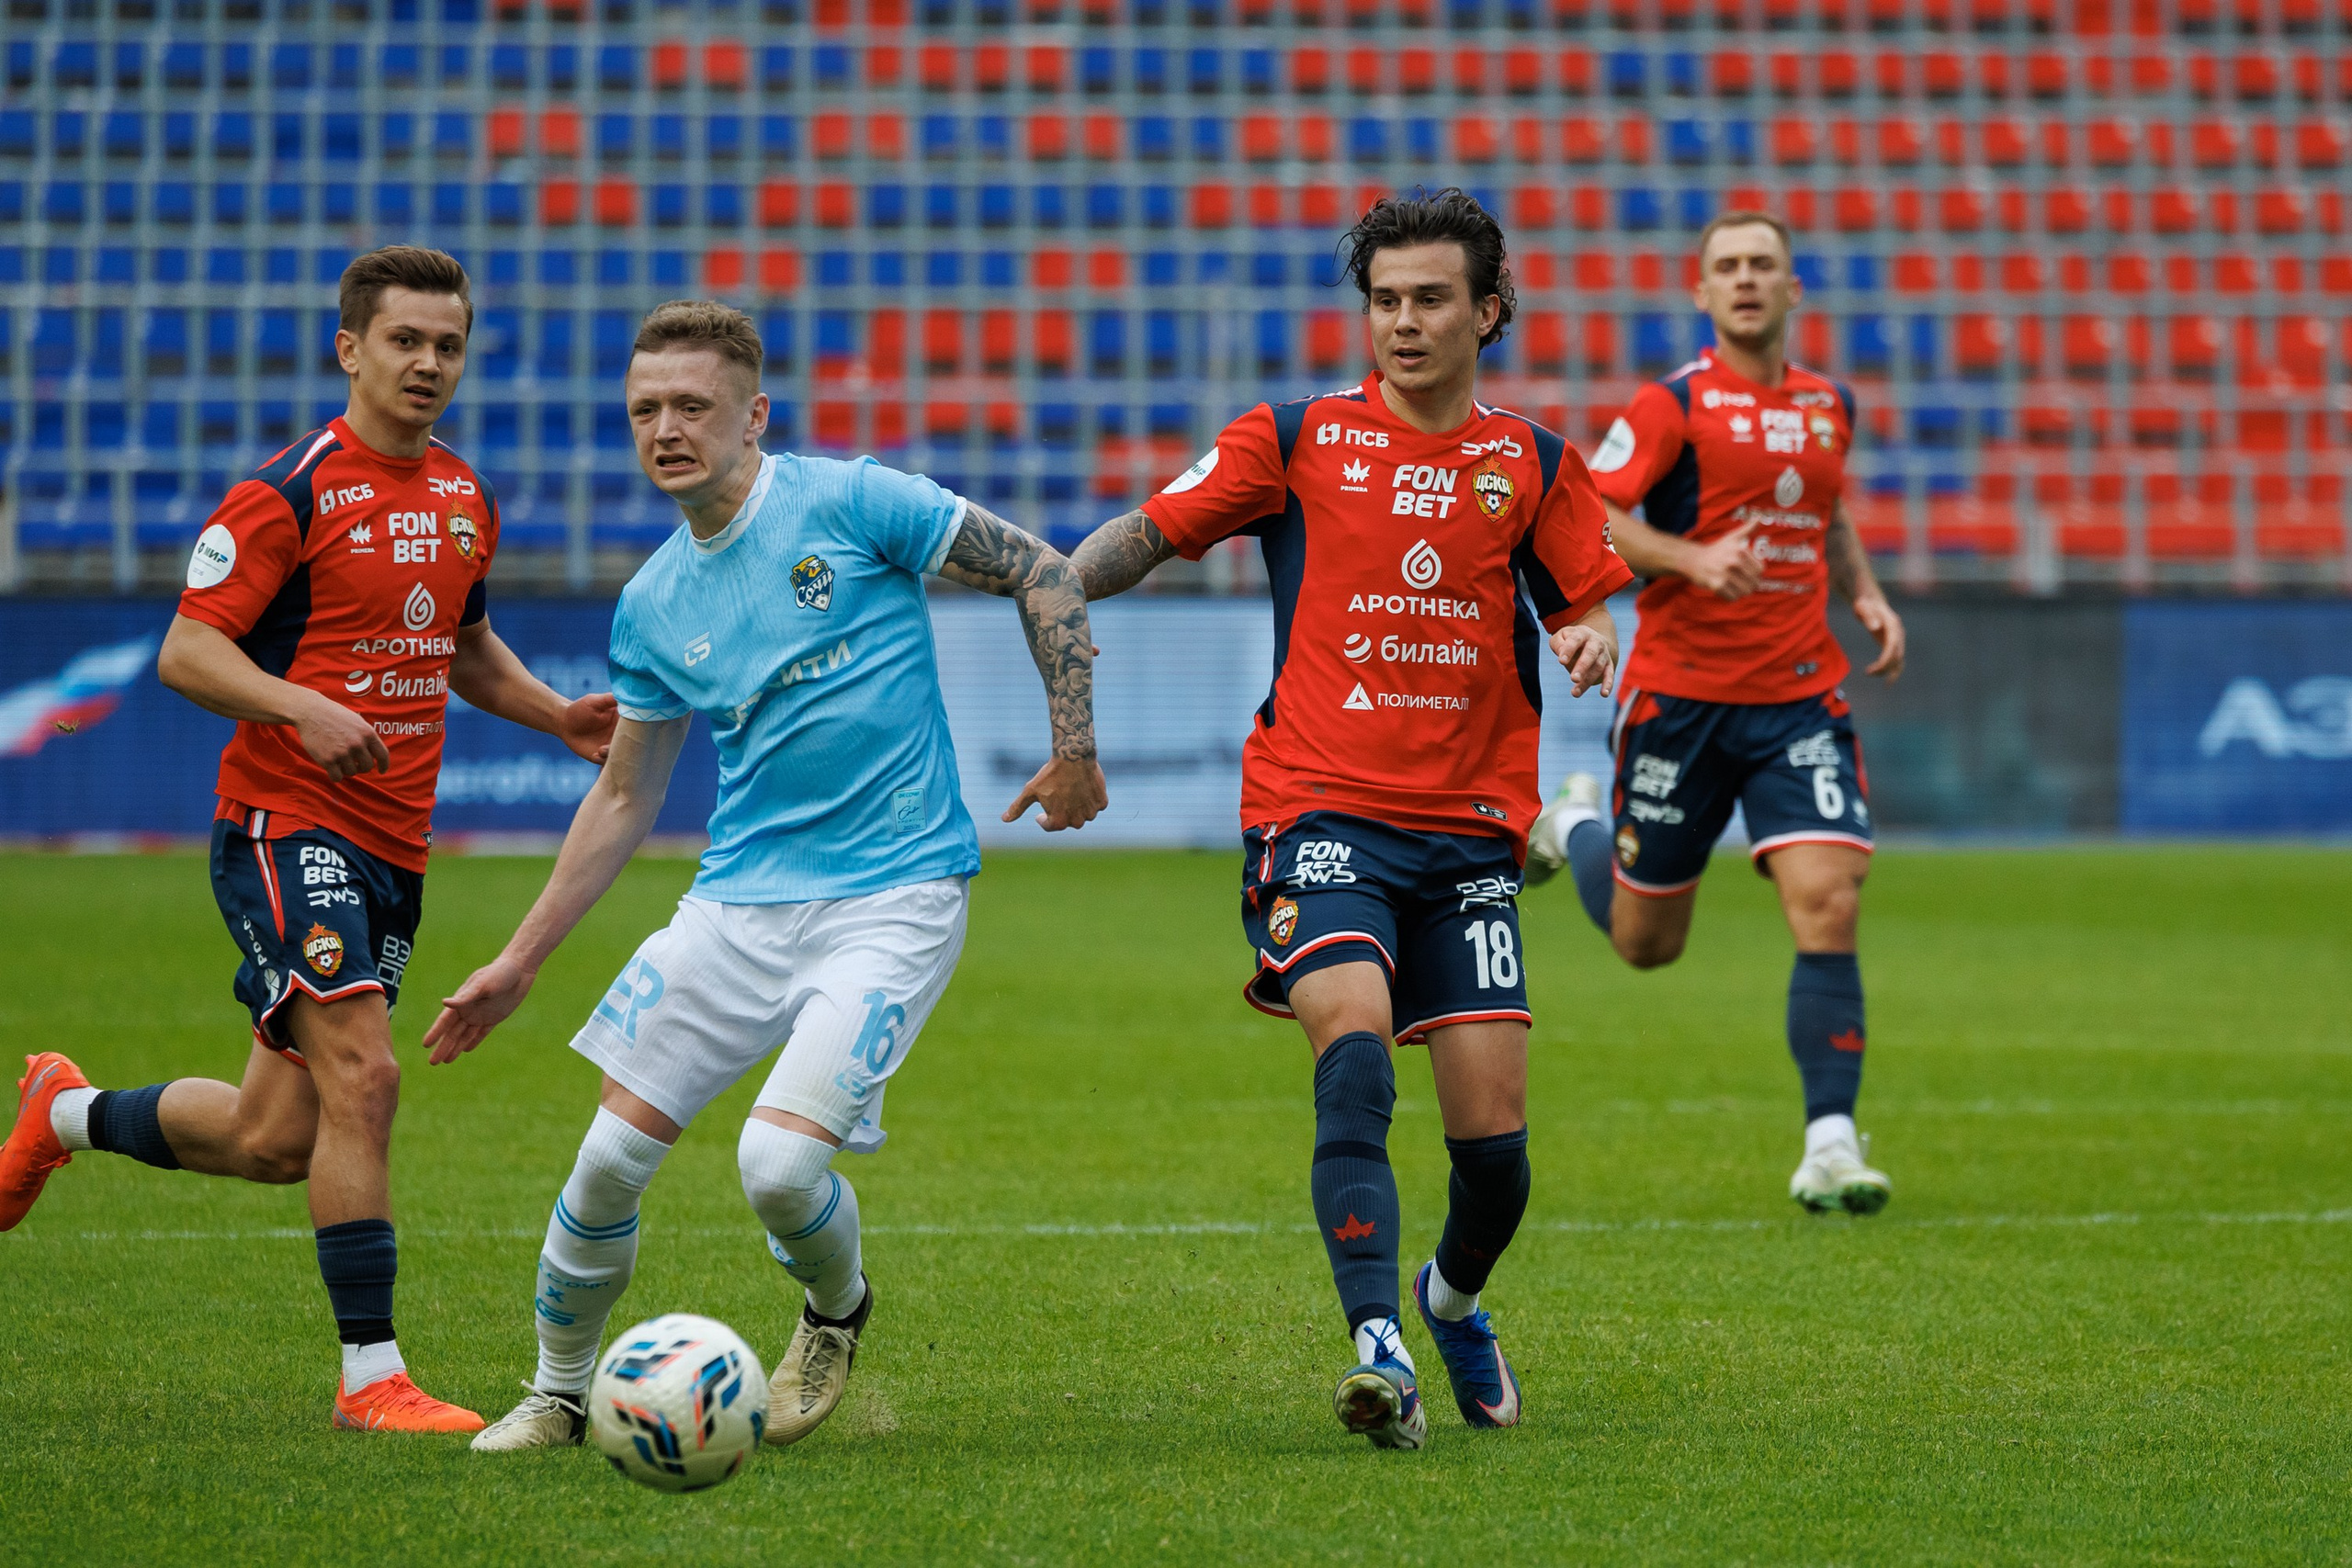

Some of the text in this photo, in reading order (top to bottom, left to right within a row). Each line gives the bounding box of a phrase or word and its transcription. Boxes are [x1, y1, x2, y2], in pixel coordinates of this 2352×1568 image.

[1345, 428, 1389, 447] ПСБ
[1392, 464, 1458, 492] FON
[1476, 473, 1511, 495] ЦСКА
[337, 483, 375, 506] ПСБ
[1391, 491, 1457, 519] BET
[389, 512, 436, 536] FON
[449, 516, 476, 536] ЦСКА
[393, 538, 441, 563] BET
[796, 570, 835, 608] Сочи
[1347, 593, 1480, 620] APOTHEKA
[351, 636, 456, 656] APOTHEKA
[1381, 635, 1478, 666] билайн
[1812, 765, 1845, 820] 6
[300, 847, 346, 867] FON
[1295, 841, 1351, 863] FON
[303, 866, 348, 885] BET
[1270, 906, 1295, 932] ЦСКА
[306, 935, 341, 958] ЦСКА
[1464, 920, 1518, 988] 18
[849, 989, 906, 1077] 16
